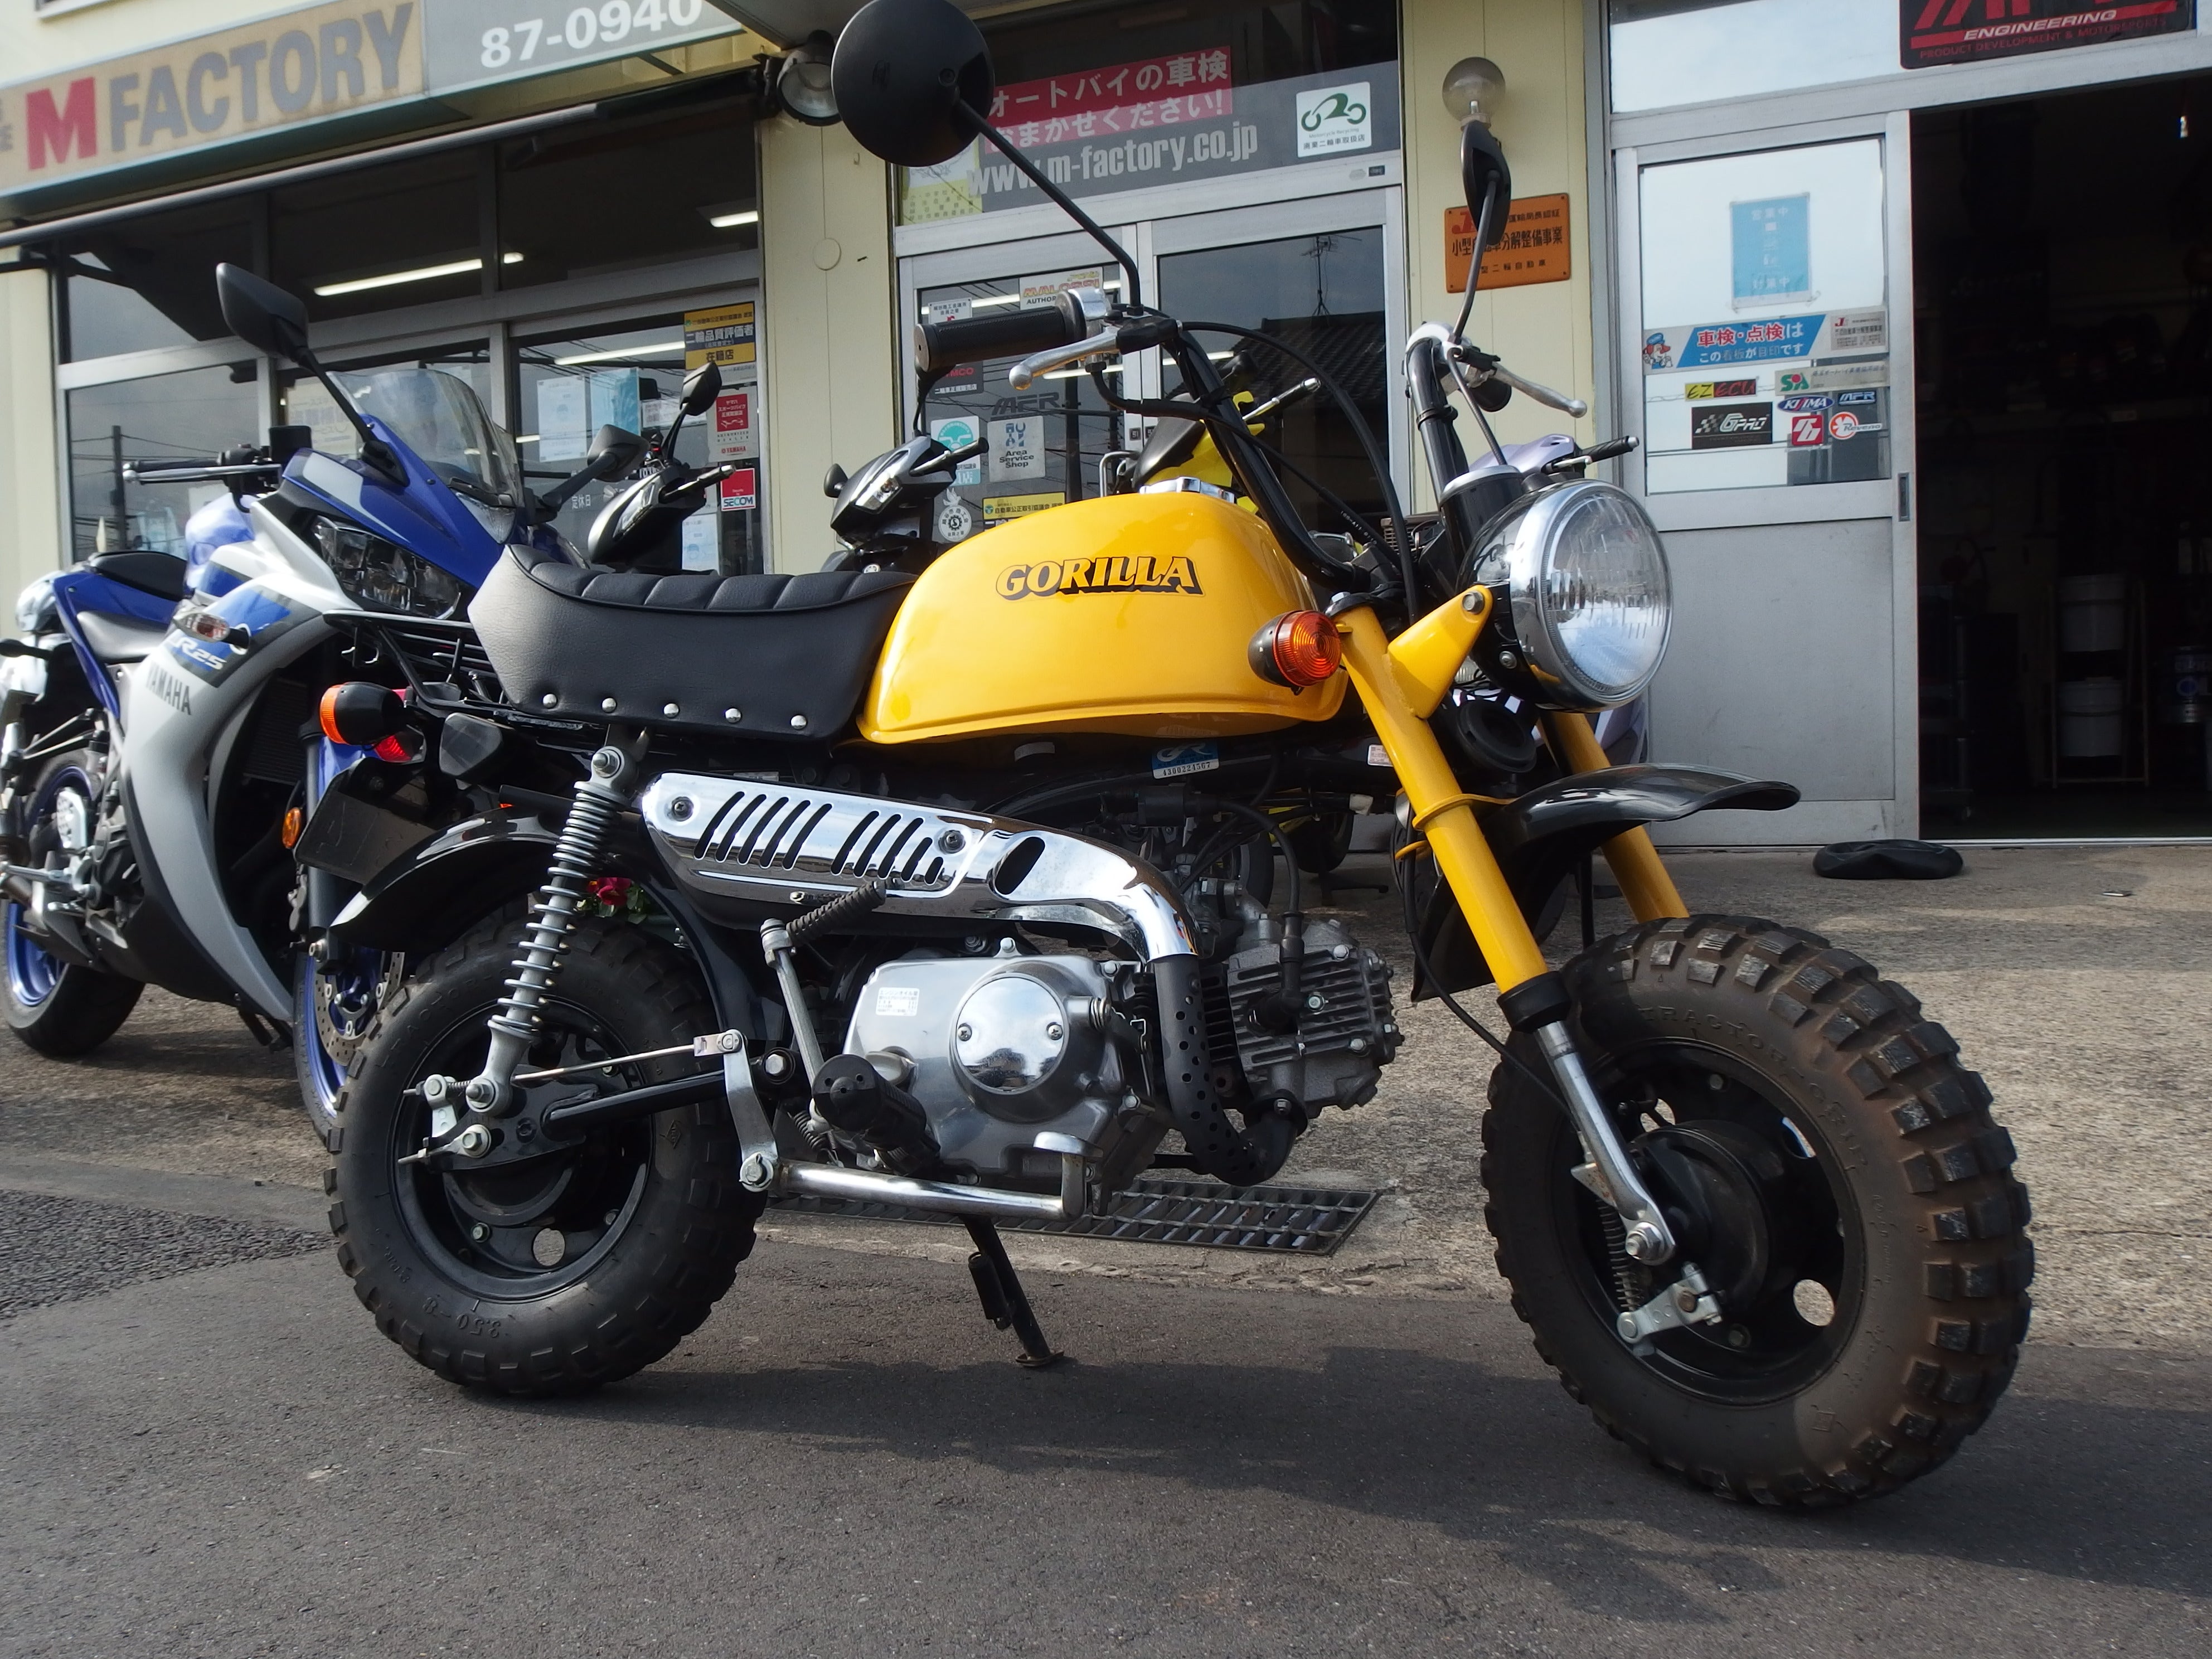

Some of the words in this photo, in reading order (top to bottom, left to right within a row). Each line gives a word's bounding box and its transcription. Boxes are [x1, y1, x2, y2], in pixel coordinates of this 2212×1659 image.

[481, 0, 702, 69] 87-0940
[1919, 44, 1972, 58] PRODUCT
[1976, 33, 2060, 51] DEVELOPMENT
[2079, 19, 2166, 37] MOTORSPORTS
[1964, 9, 2117, 41] ENGINEERING
[26, 77, 96, 170] M
[109, 2, 414, 152] FACTORY
[989, 50, 1228, 118] オートバイの車検
[967, 122, 1258, 196] wwwm-factory.co.jp
[1508, 208, 1560, 223] 運輸局長認証
[1481, 259, 1546, 274] 型二輪自動車
[1687, 384, 1713, 399] EZ
[1716, 380, 1756, 396] ECU
[999, 454, 1034, 463] Service
[724, 496, 753, 507] SECOM
[996, 556, 1204, 600] GORILLA
[145, 659, 192, 716] YAMAHA
